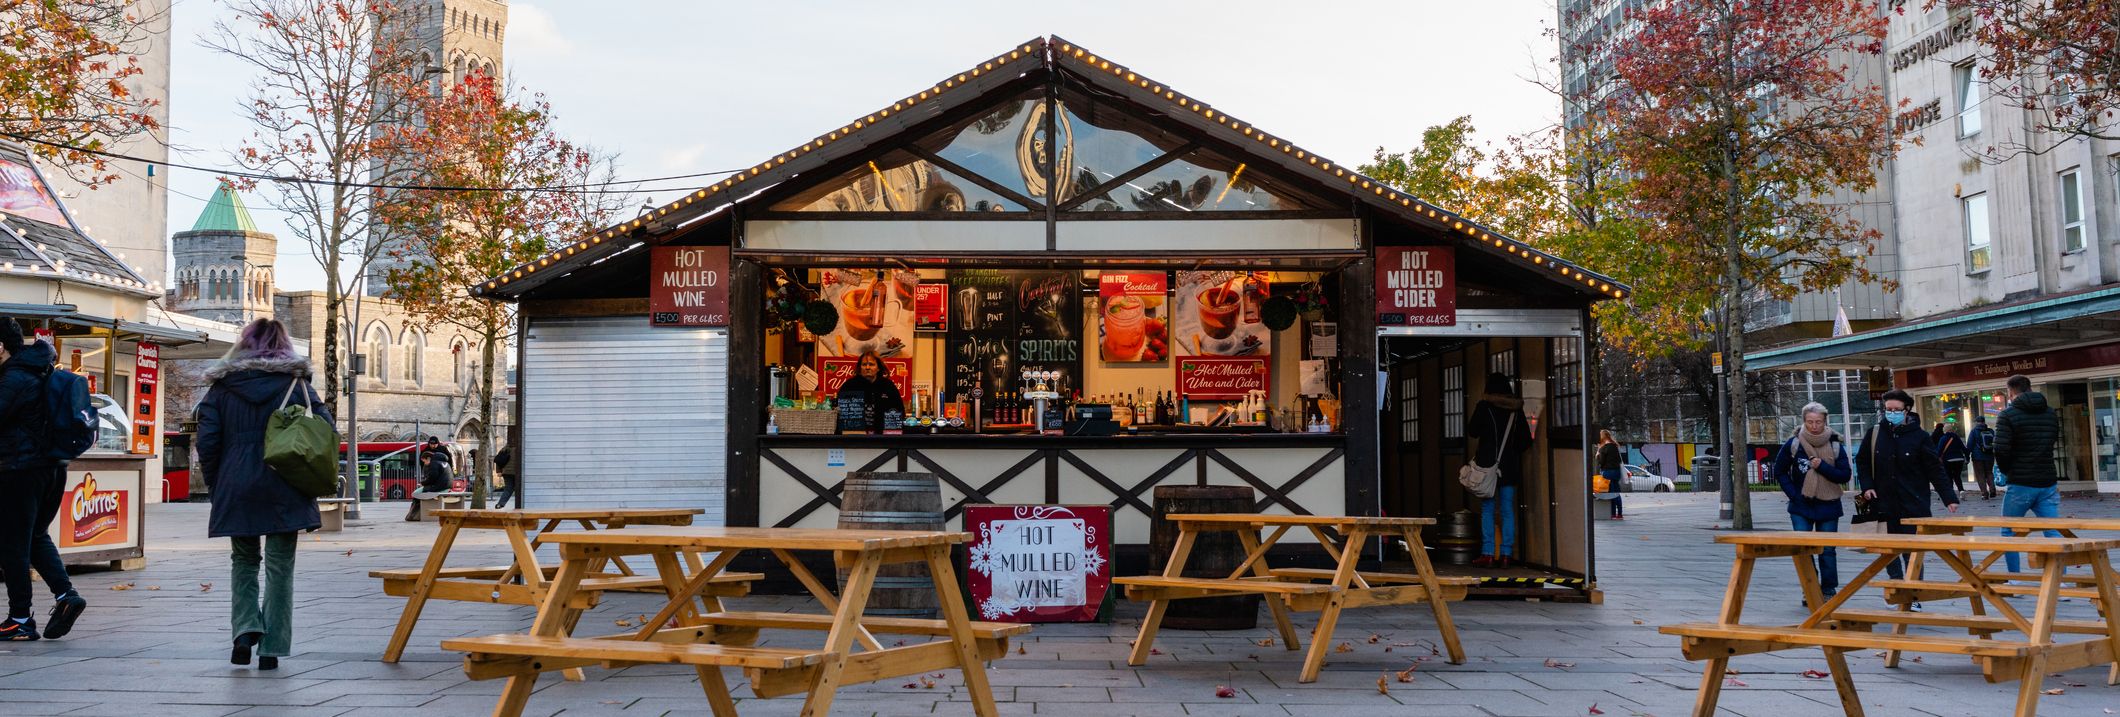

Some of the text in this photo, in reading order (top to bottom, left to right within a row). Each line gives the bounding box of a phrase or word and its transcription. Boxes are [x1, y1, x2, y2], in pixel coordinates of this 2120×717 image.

[1892, 19, 1973, 73] ASSURANCE
[675, 249, 704, 268] HOT
[1401, 250, 1429, 270] HOT
[662, 270, 717, 288] MULLED
[1102, 275, 1128, 283] GIN FIZZ
[1123, 281, 1158, 291] Cocktail
[1387, 270, 1443, 289] MULLED
[673, 290, 706, 307] WINE
[986, 291, 1003, 301] HALF
[1394, 289, 1437, 308] CIDER
[683, 314, 698, 324] PER
[700, 313, 723, 324] GLASS
[986, 312, 1004, 321] PINT
[1410, 315, 1425, 325] PER
[1425, 314, 1450, 325] GLASS
[1020, 339, 1077, 361] SPIRITS
[137, 356, 157, 369] Churros
[1193, 363, 1253, 376] Hot Mulled
[1974, 357, 2047, 375] The Edinburgh Woollen Mill
[1185, 376, 1260, 389] Wine and Cider
[73, 488, 118, 521] Churros
[1020, 525, 1055, 545] HOT
[1001, 552, 1076, 572] MULLED
[1014, 578, 1064, 599] WINE
